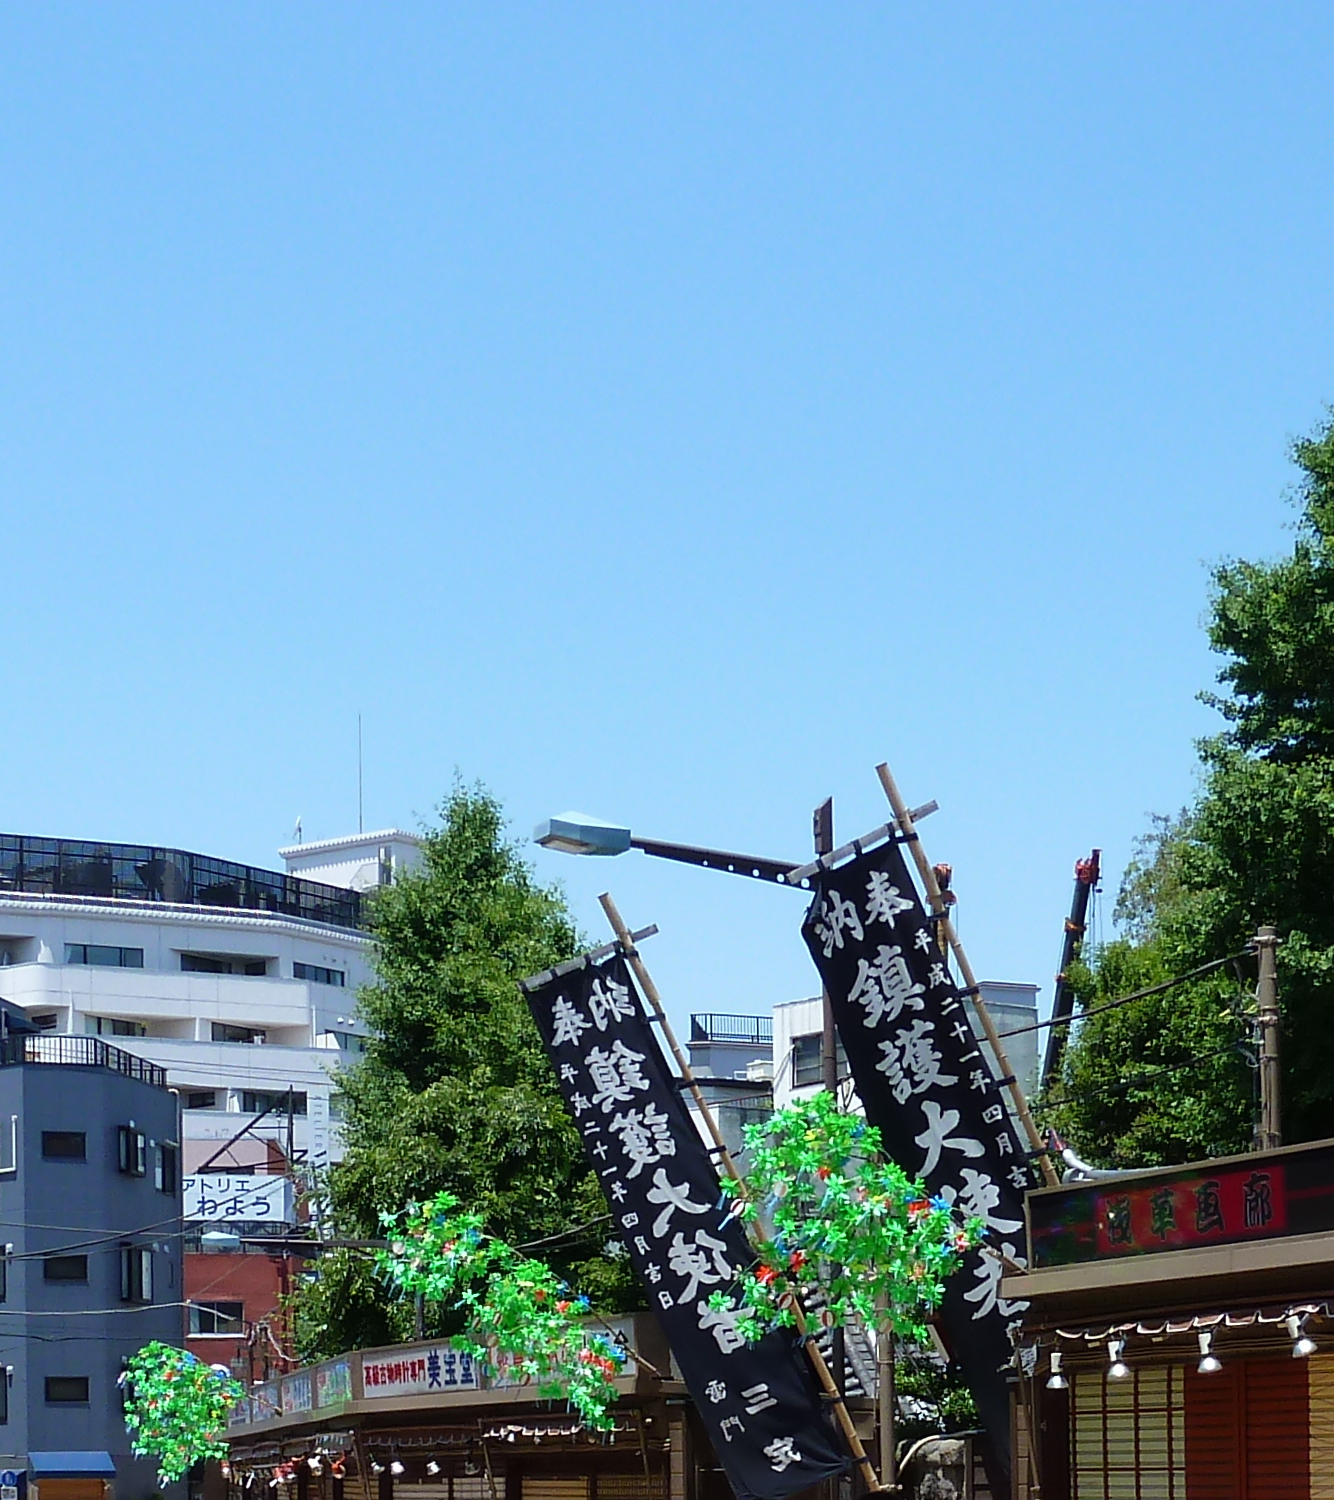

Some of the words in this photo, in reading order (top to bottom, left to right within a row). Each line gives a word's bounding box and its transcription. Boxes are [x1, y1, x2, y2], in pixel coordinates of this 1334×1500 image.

[182, 1177, 251, 1194] アトリエ
[196, 1195, 272, 1217] わよう
